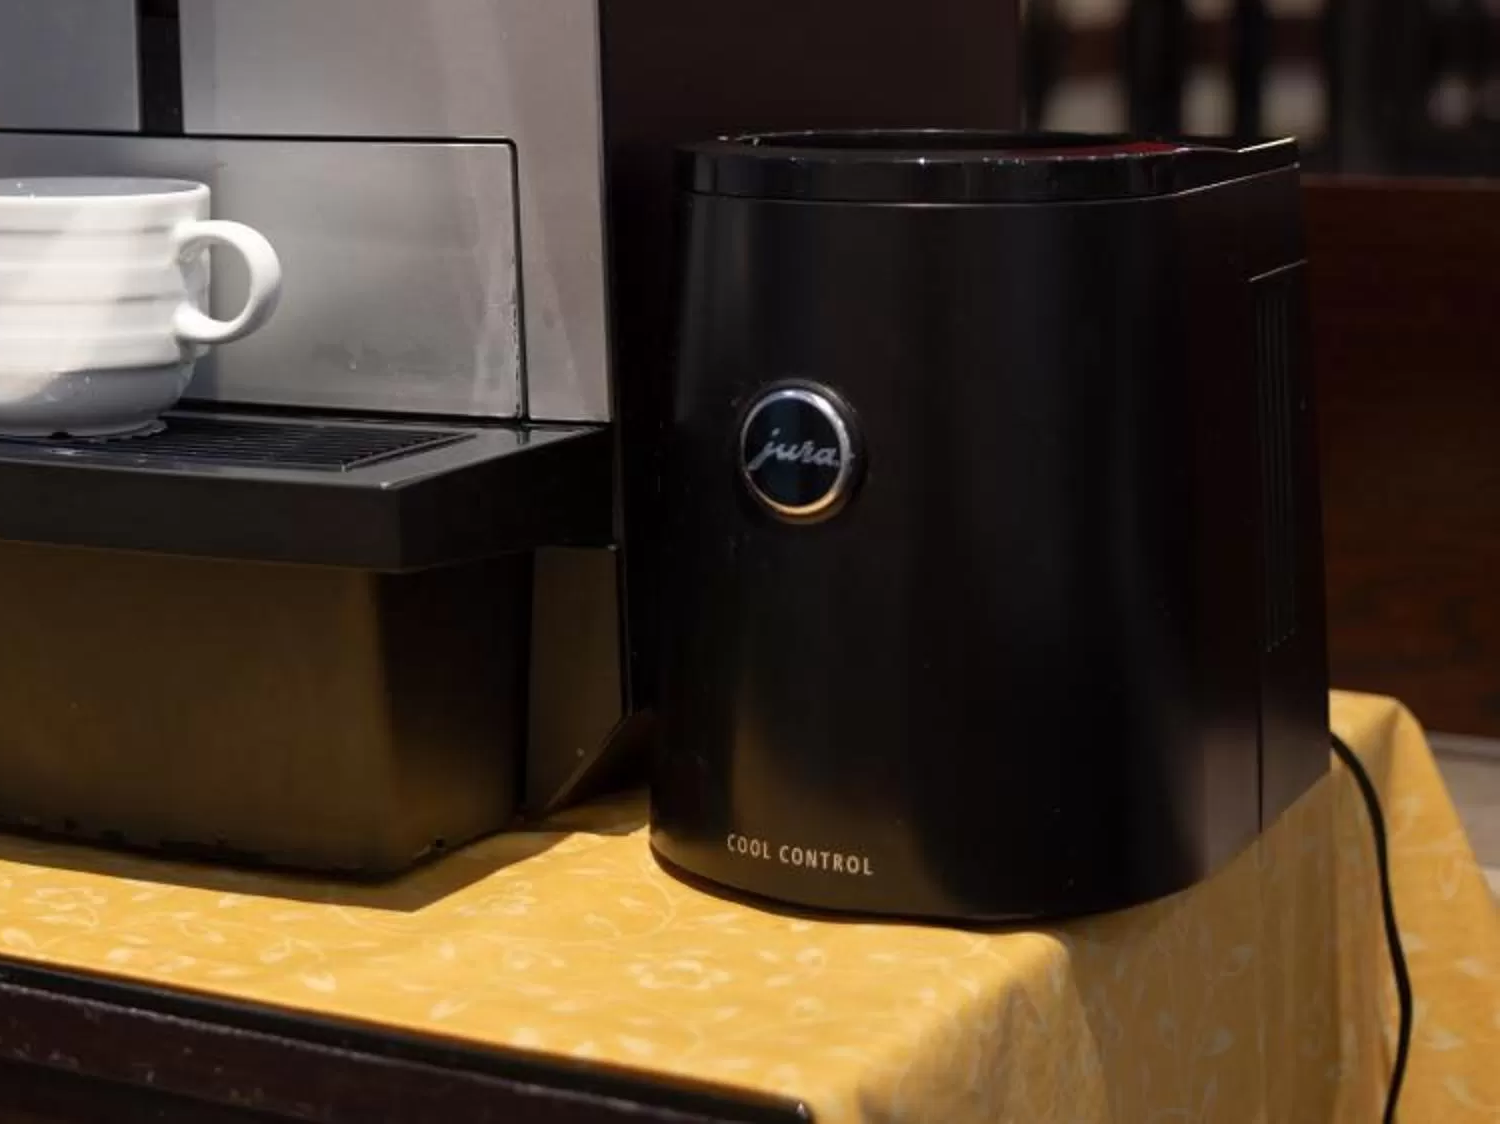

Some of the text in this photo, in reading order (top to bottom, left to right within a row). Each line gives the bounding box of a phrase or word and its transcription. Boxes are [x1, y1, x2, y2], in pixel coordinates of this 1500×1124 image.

[748, 428, 840, 471] jura
[727, 833, 874, 875] COOL CONTROL
